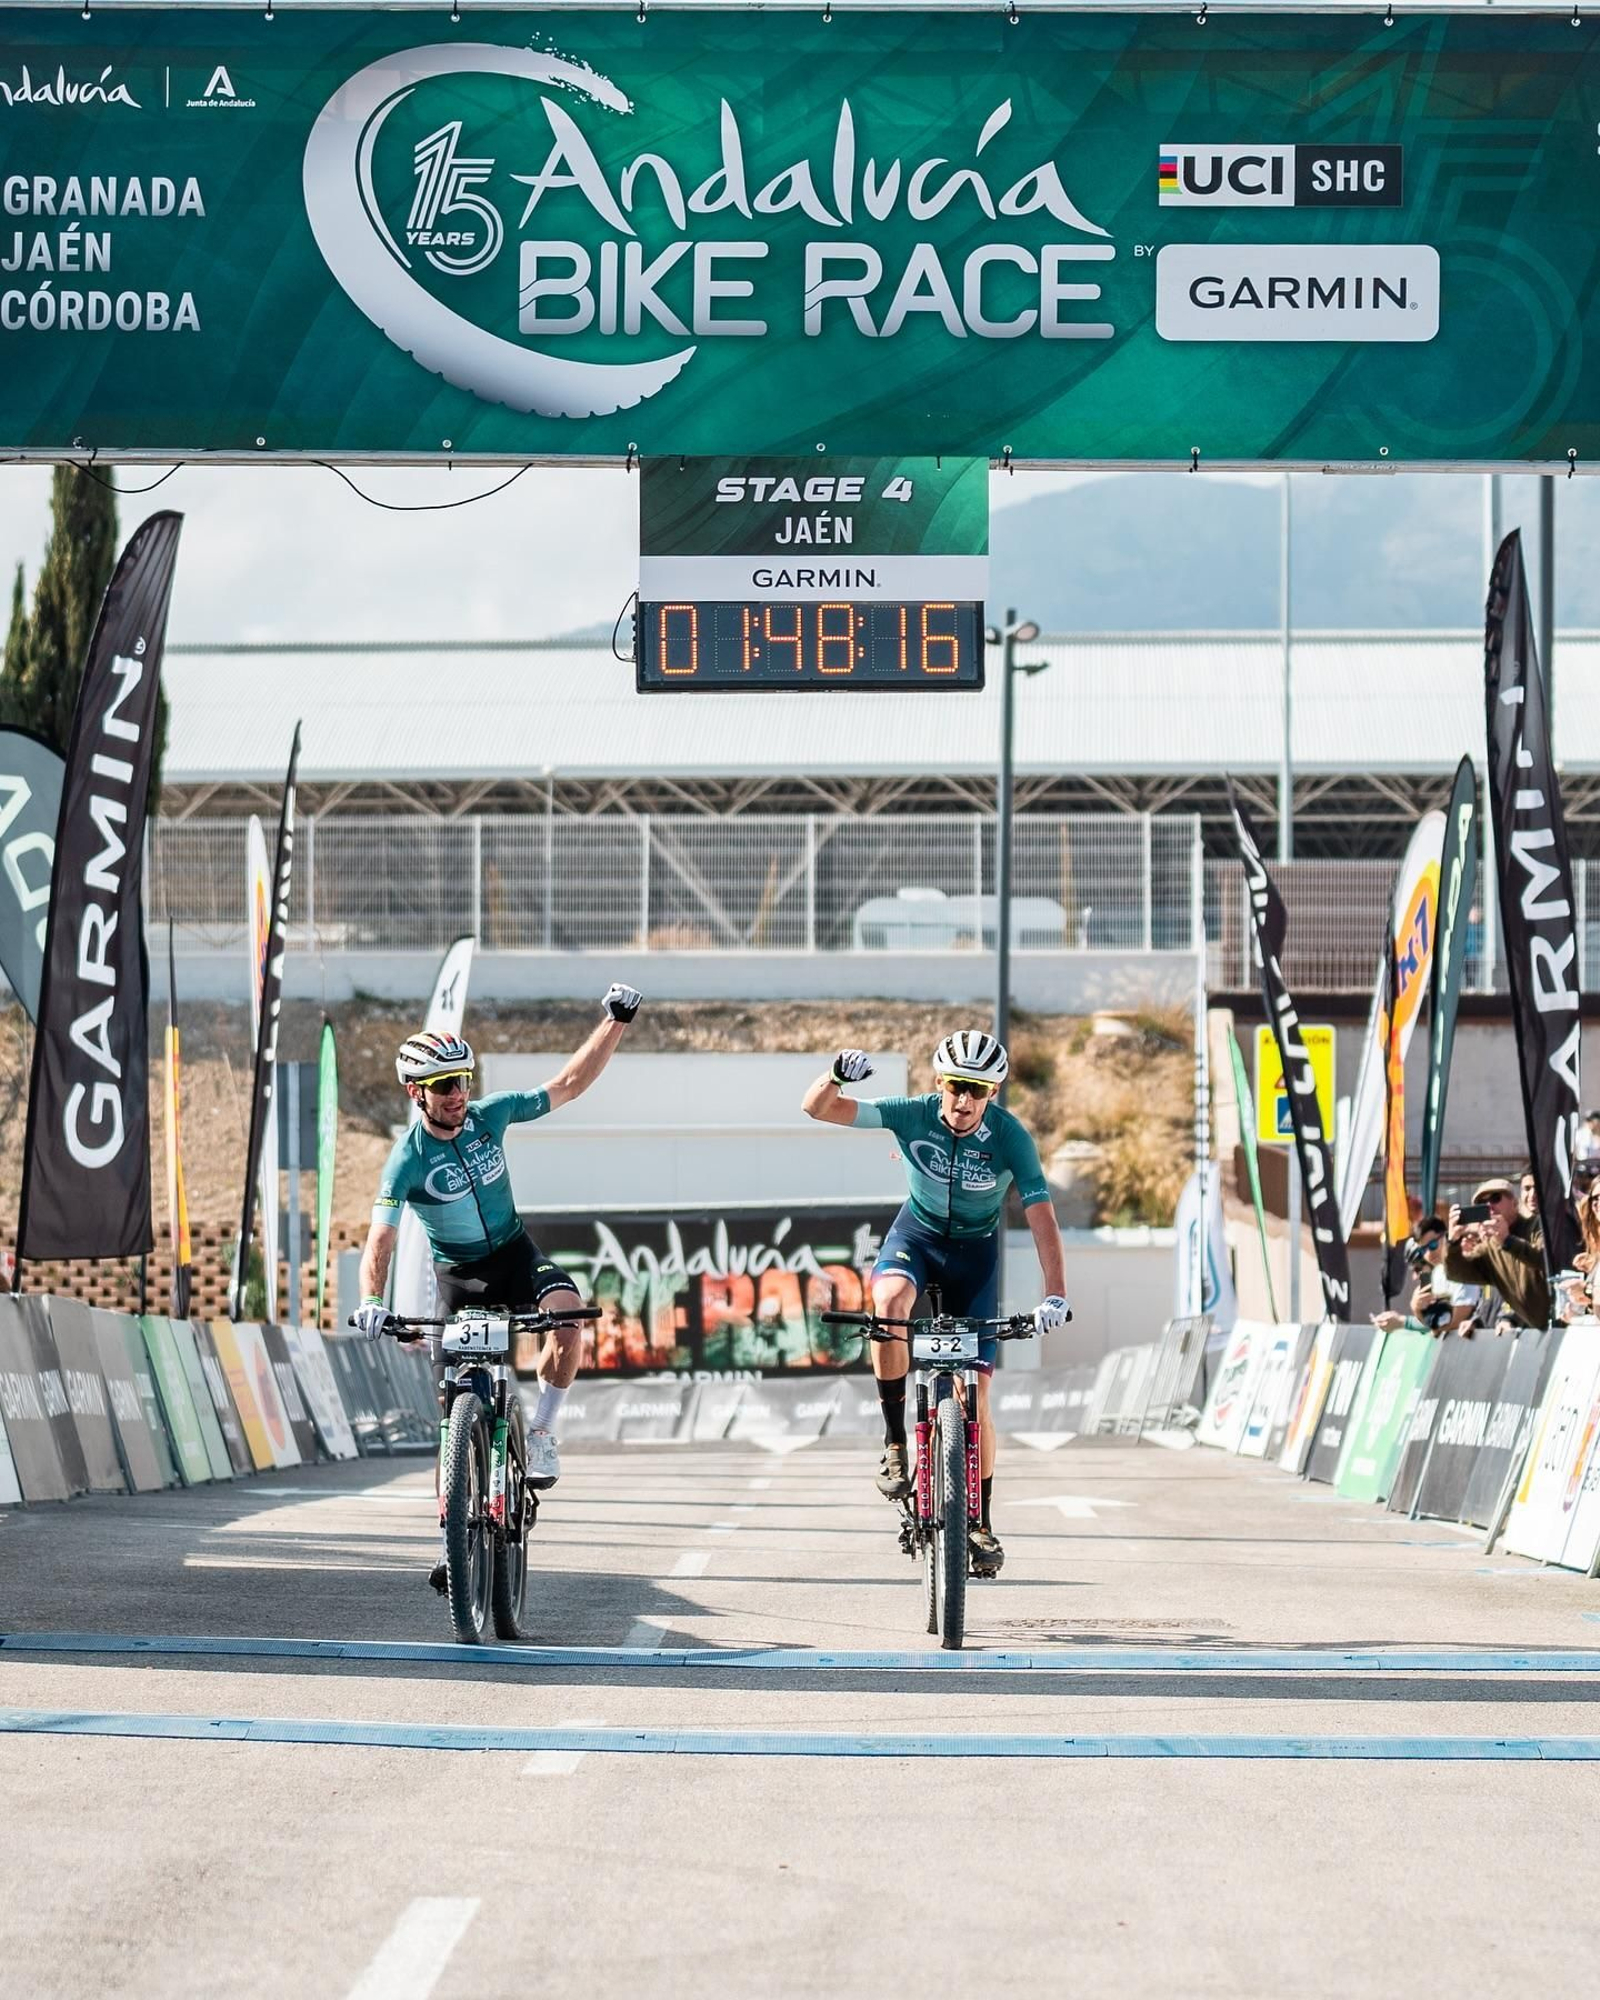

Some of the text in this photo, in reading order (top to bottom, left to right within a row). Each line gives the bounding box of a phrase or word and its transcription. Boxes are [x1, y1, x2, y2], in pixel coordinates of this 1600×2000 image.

[186, 98, 256, 108] Junta de Andalucía
[510, 96, 1113, 237] Andalucía
[1181, 155, 1285, 196] UCI
[1311, 159, 1386, 192] SHC
[3, 175, 206, 218] GRANADA
[1, 221, 111, 273] JAÉN
[406, 231, 476, 246] YEARS
[1133, 245, 1155, 258] BY
[1, 280, 202, 332] CÓRDOBA
[519, 240, 1116, 339] BIKE RACE
[715, 476, 913, 502] STAGE 4
[775, 510, 853, 544] JAÉN
[590, 1216, 833, 1284] Andalucía
[459, 1323, 490, 1346] 3-1
[930, 1337, 962, 1353] 3-2
[615, 1402, 682, 1418] GARMIN
[918, 1443, 930, 1510] MANITOU
[967, 1443, 979, 1510] MANITOU
